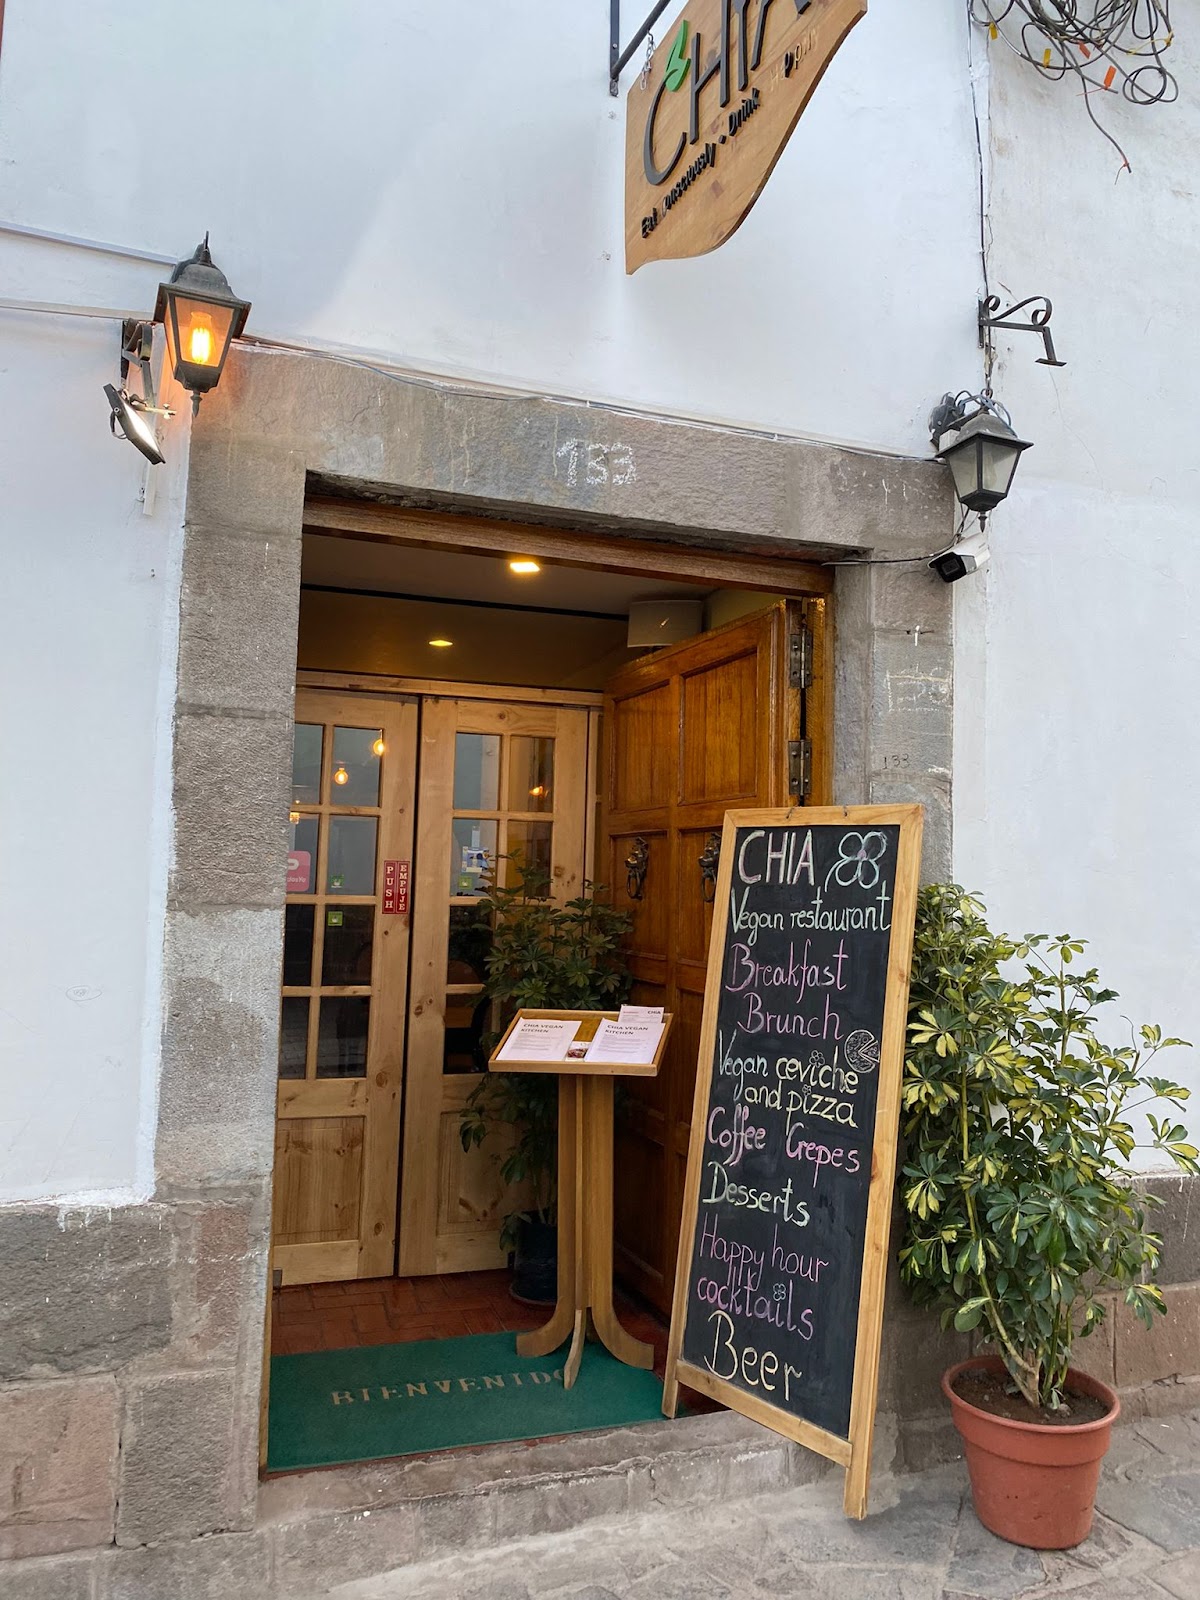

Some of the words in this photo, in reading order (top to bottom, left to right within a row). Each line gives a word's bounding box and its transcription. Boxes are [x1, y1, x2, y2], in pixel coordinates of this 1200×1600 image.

[728, 87, 760, 136] Drink
[882, 753, 911, 770] 133
[385, 866, 394, 909] PUSH
[399, 864, 408, 911] EMPUJE
[738, 829, 815, 886] CHIA
[731, 886, 784, 946] Vegan
[790, 880, 892, 932] restaurant
[725, 938, 849, 1004] Breakfast
[737, 992, 844, 1041] Brunch
[719, 1029, 769, 1101] Vegan
[776, 1045, 859, 1094] ceviche
[744, 1079, 783, 1111] and
[786, 1087, 859, 1136] pizza
[708, 1103, 767, 1167] Coffee
[785, 1122, 860, 1189] Crepes
[702, 1161, 811, 1227] Desserts
[700, 1212, 765, 1291] Happy
[771, 1223, 829, 1283] hour
[697, 1266, 814, 1341] cocktails
[703, 1310, 802, 1401] Beer
